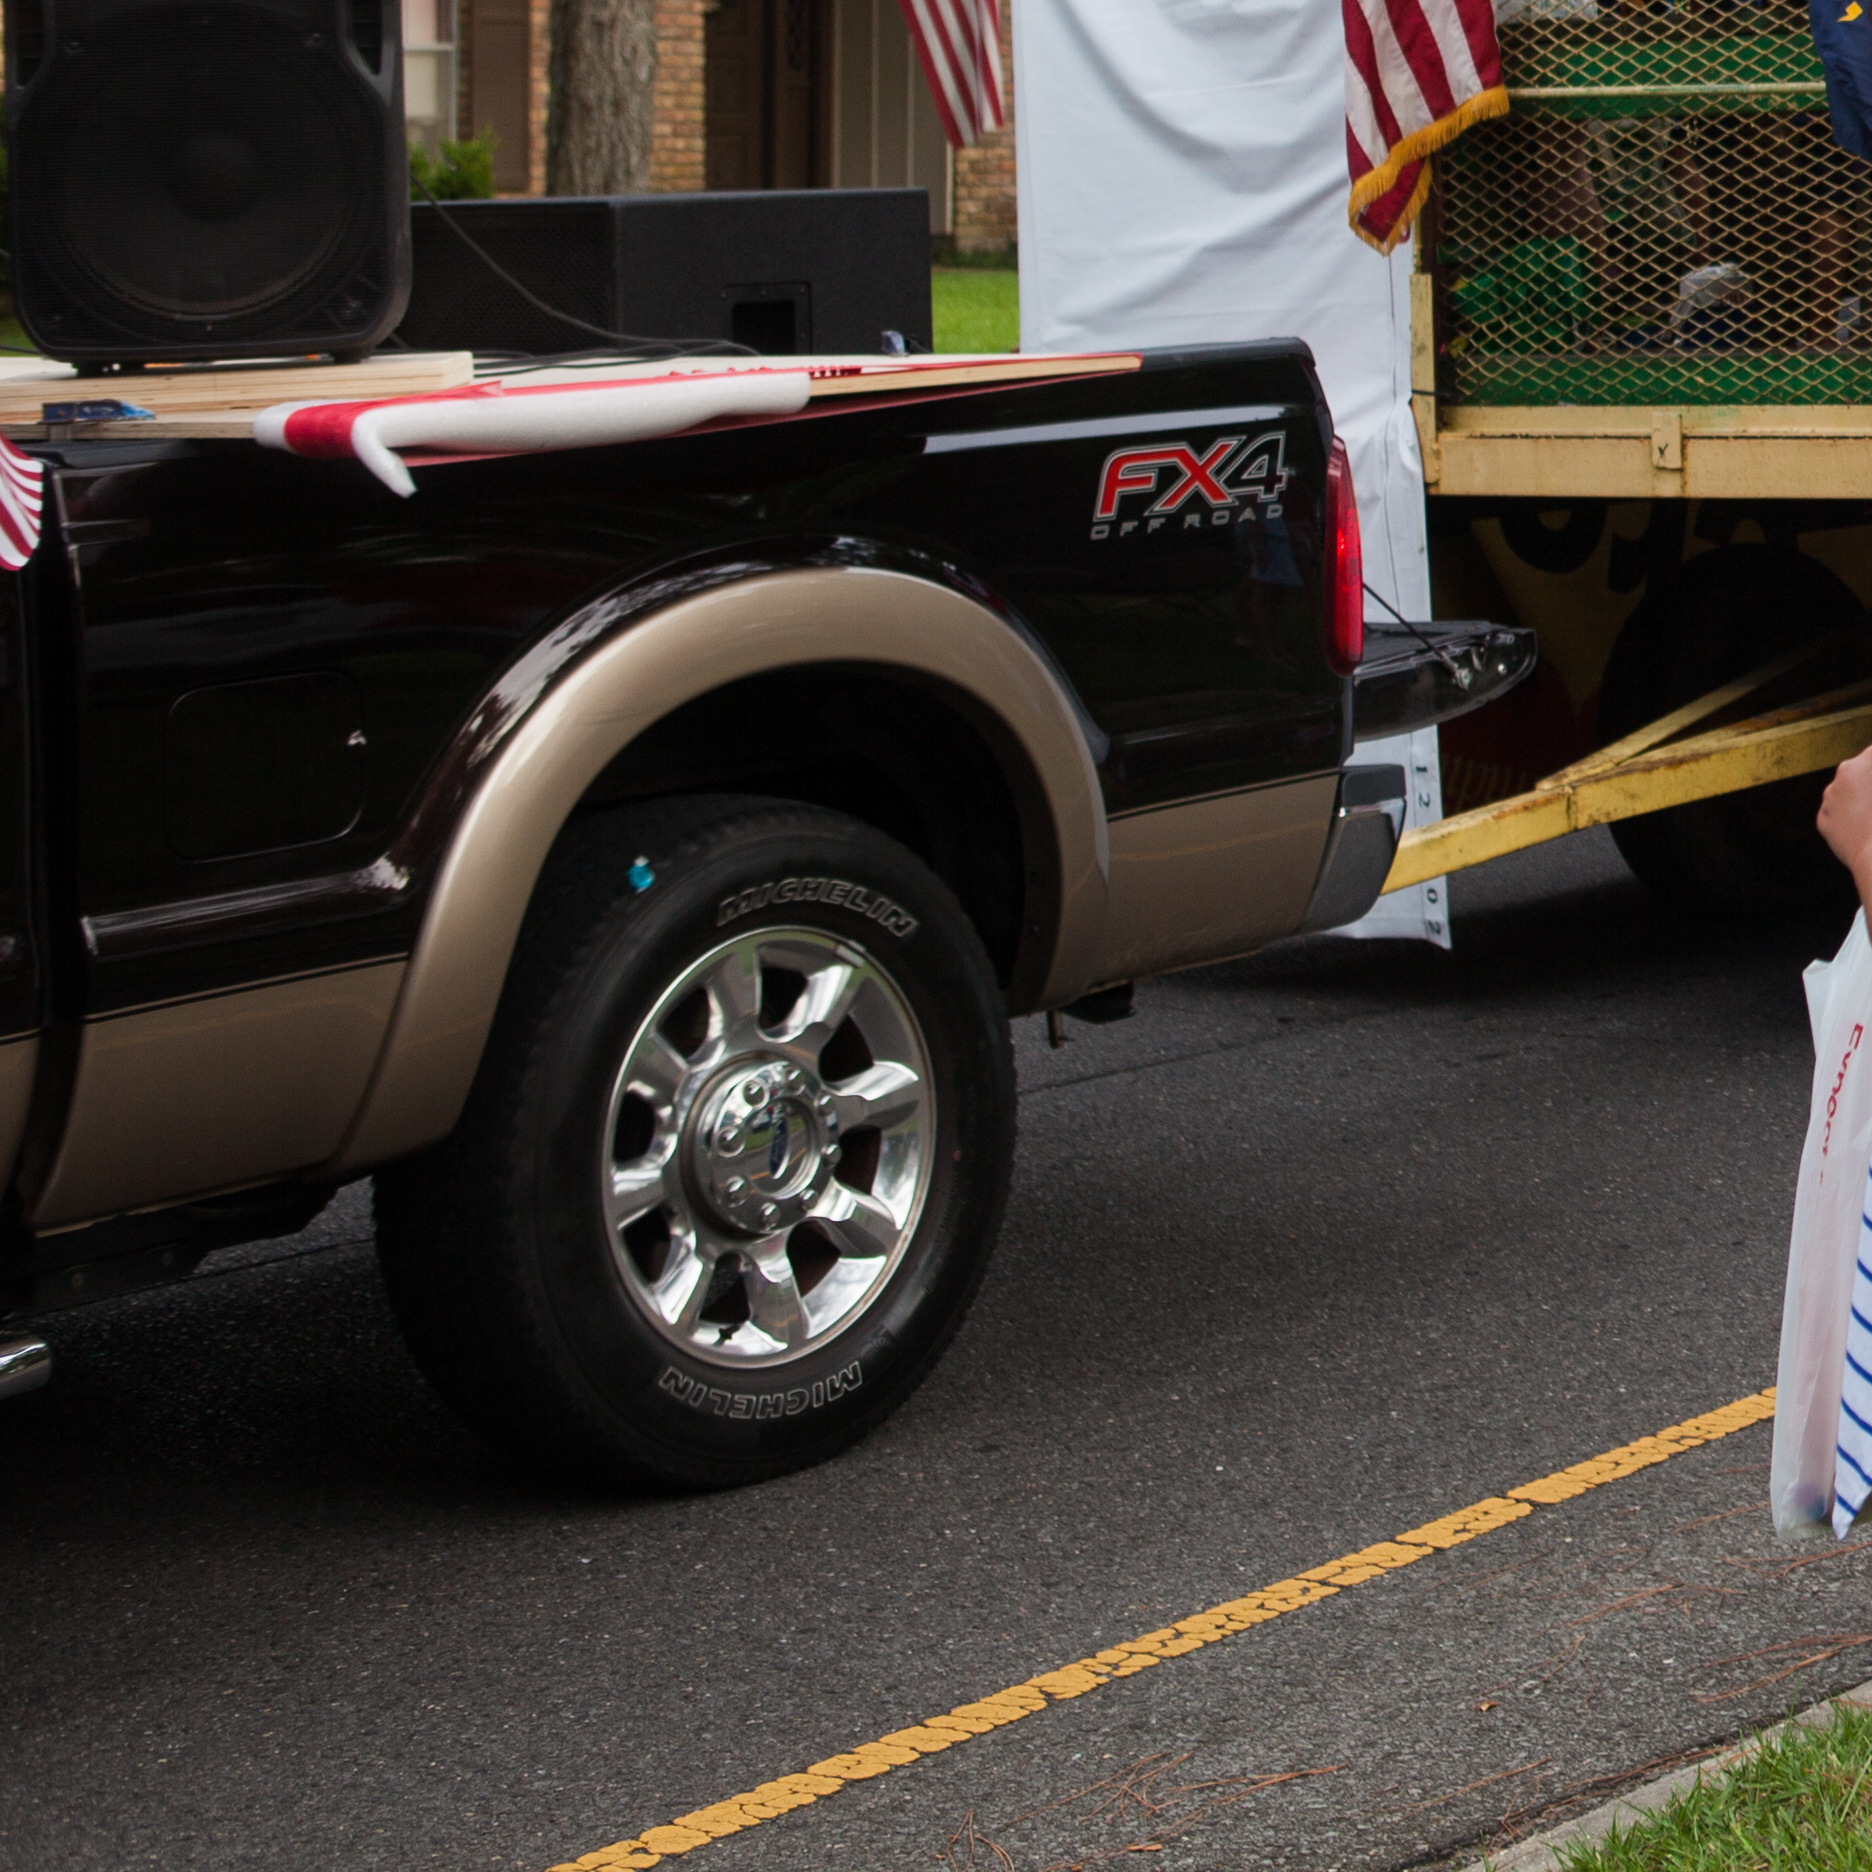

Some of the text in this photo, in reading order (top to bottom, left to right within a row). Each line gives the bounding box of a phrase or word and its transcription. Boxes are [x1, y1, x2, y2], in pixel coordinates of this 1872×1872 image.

[1093, 431, 1288, 523] FX4
[1090, 503, 1284, 541] OFF ROAD
[715, 876, 921, 938] MICHELIN
[657, 1358, 863, 1420] MICHELIN
